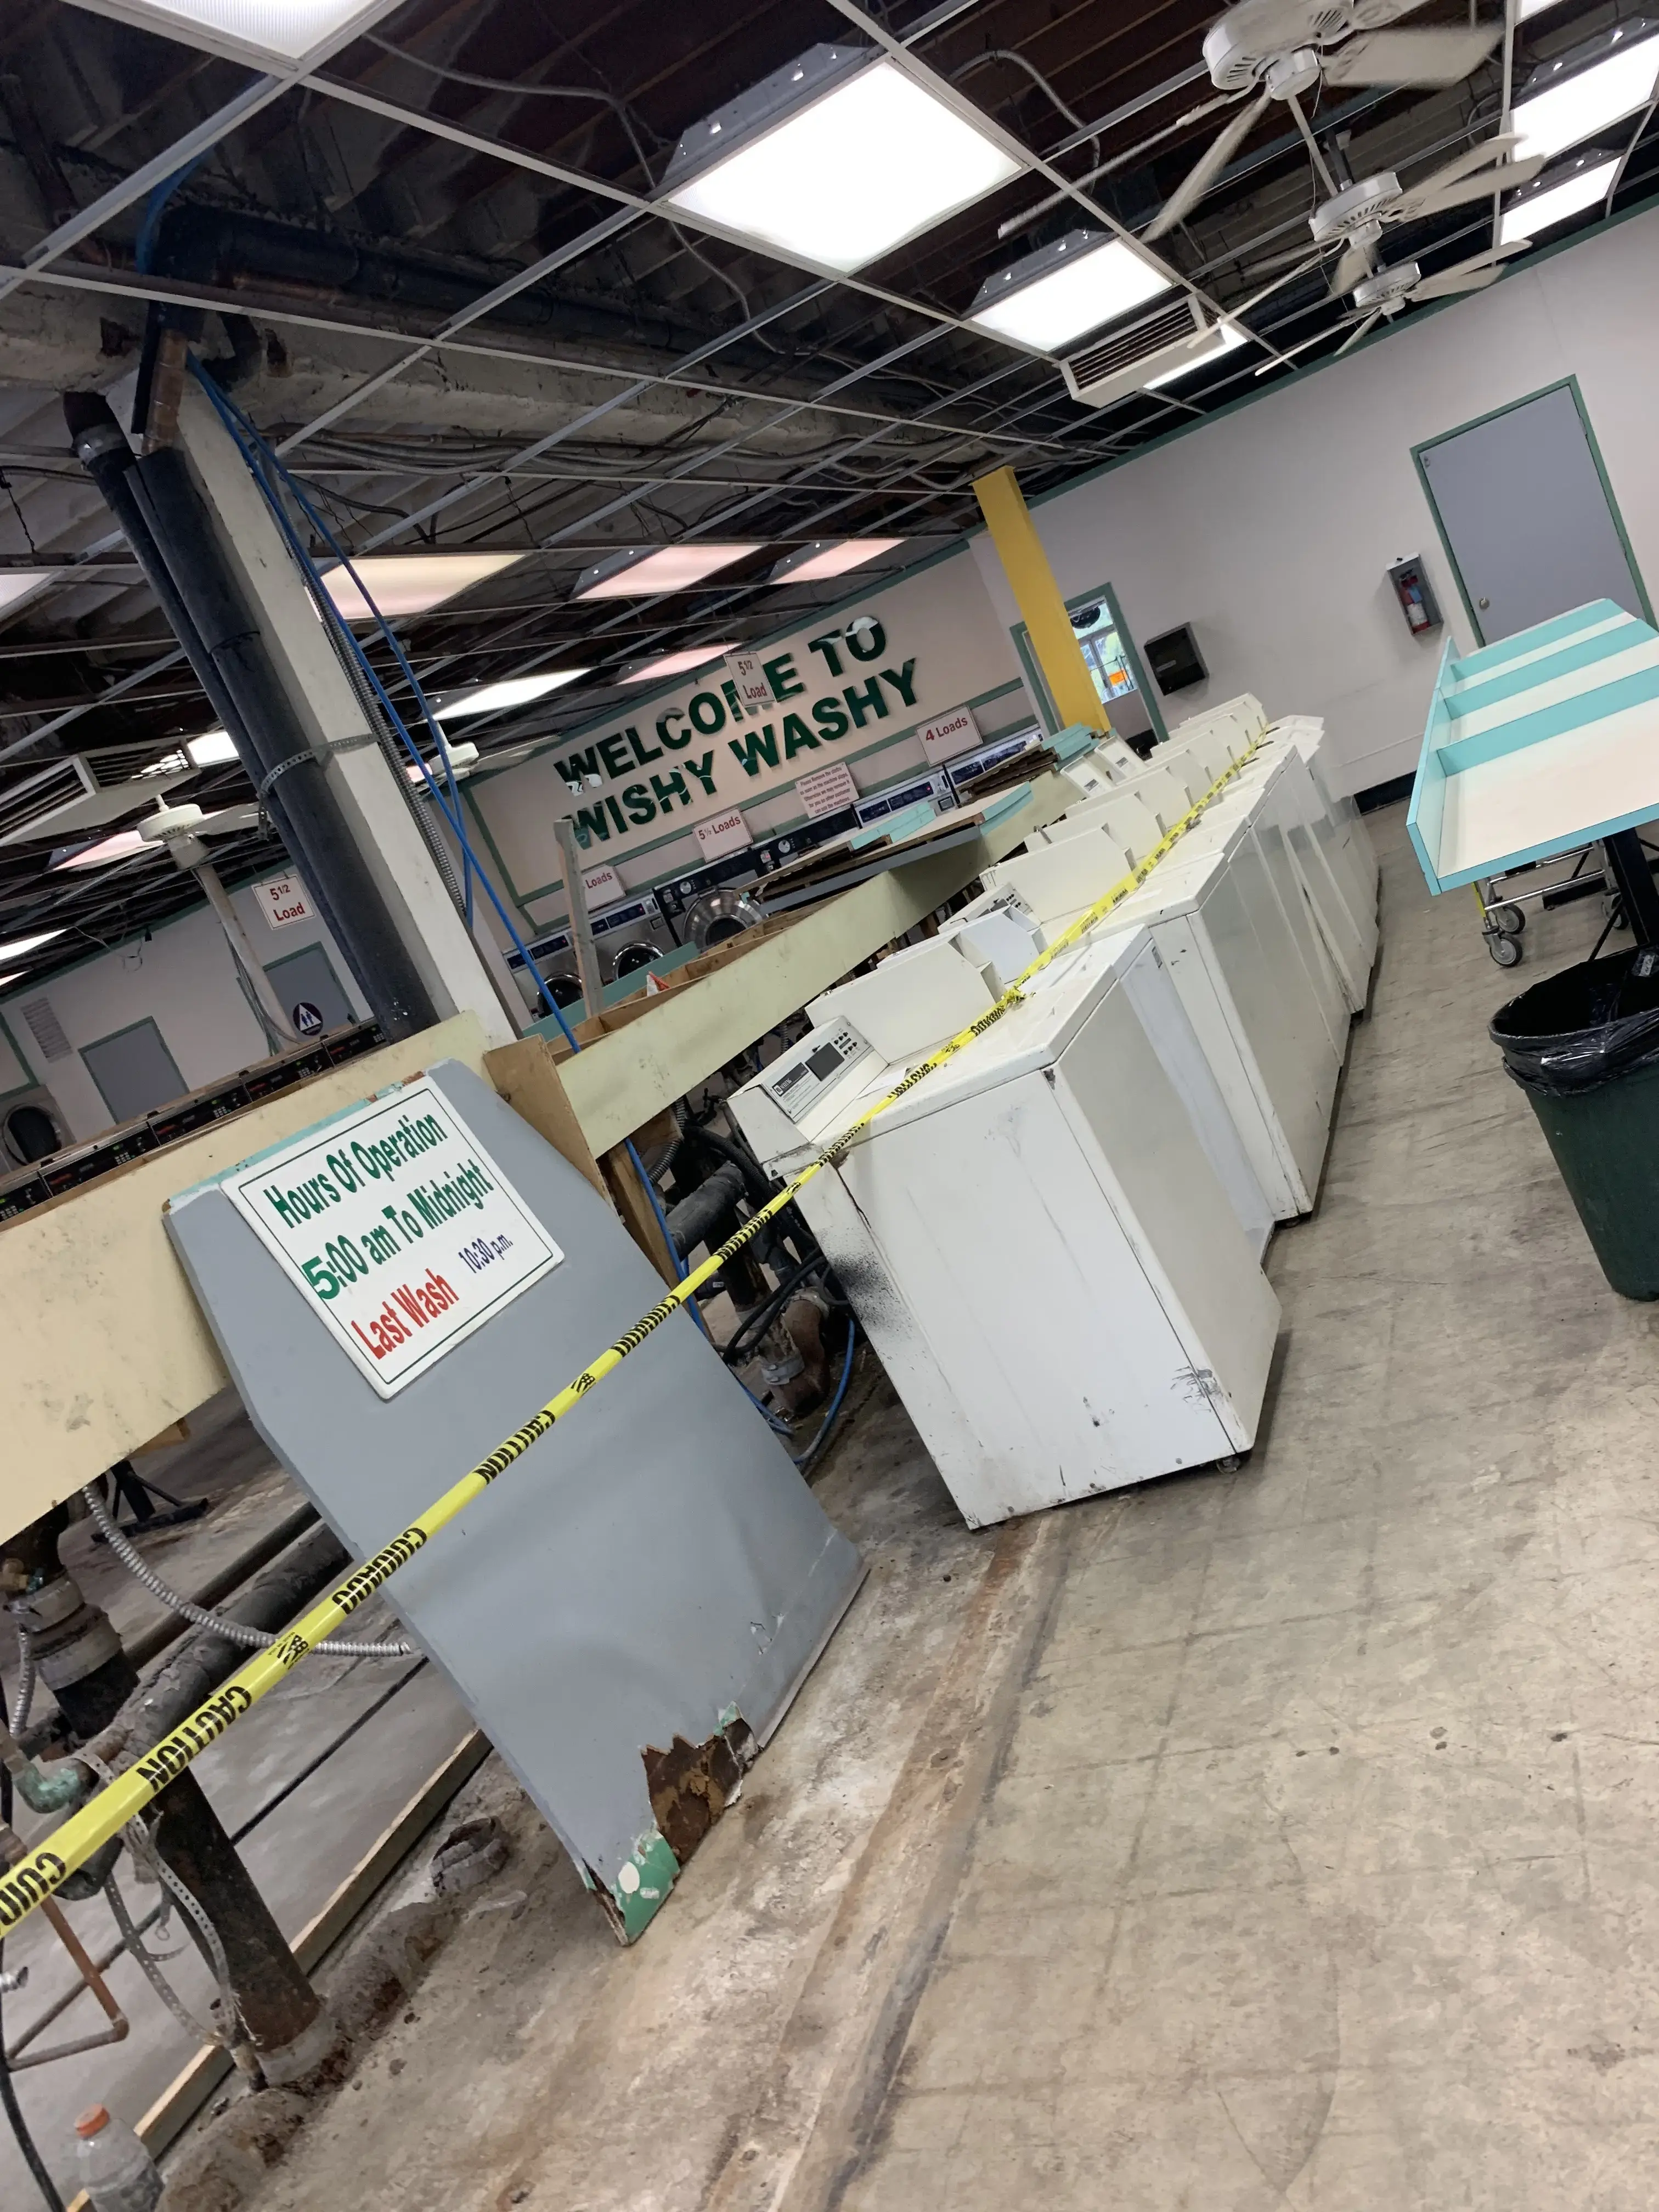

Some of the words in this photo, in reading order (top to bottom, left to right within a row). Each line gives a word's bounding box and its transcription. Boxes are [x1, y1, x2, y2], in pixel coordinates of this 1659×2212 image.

[808, 616, 887, 678] TO
[742, 682, 768, 699] Load
[561, 750, 716, 850] WISHY
[728, 658, 917, 776] WASHY
[926, 729, 935, 741] 4
[935, 717, 968, 738] Loads
[712, 816, 741, 834] Loads
[273, 901, 306, 921] Load
[585, 872, 613, 889] Loads
[263, 1173, 341, 1228] Hours
[326, 1149, 365, 1193] Of
[351, 1114, 448, 1182] Operation
[407, 1158, 494, 1229] Midnight
[361, 1224, 402, 1266] am
[381, 1205, 424, 1244] To
[302, 1234, 369, 1299] 5:00
[351, 1302, 413, 1359] Last
[391, 1269, 459, 1328] Wash
[458, 1238, 494, 1273] 10:30
[490, 1233, 514, 1261] p.m.
[472, 1409, 556, 1485] CAUTION
[332, 1527, 427, 1615] CUIDADO
[136, 1685, 252, 1792] CAUTION
